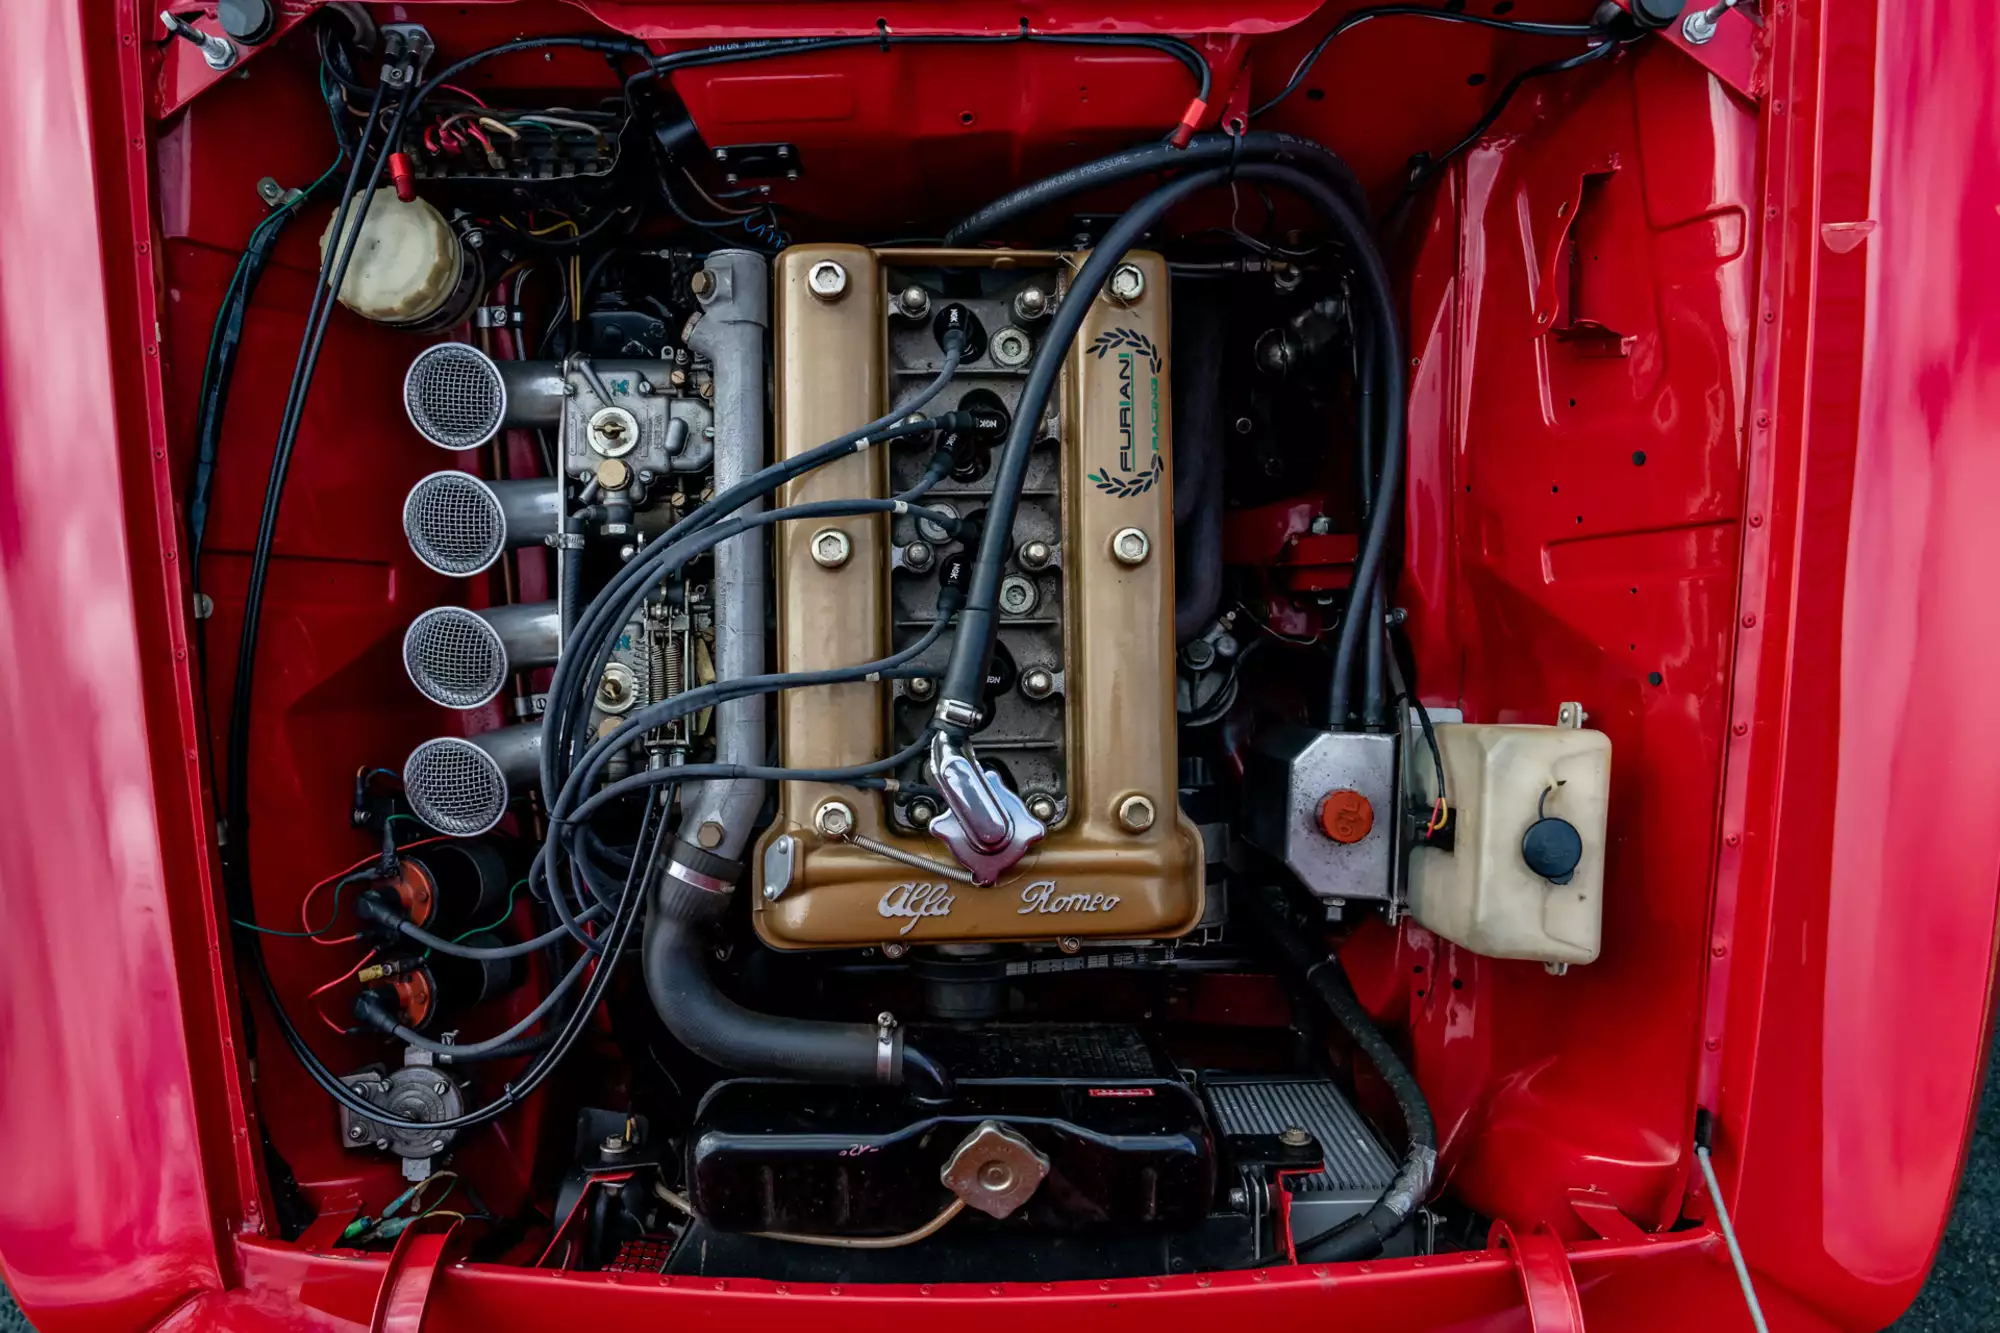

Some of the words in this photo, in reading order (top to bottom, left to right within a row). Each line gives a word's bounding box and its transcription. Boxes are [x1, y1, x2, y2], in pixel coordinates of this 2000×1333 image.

[1034, 171, 1076, 192] WORKING
[1080, 154, 1130, 177] PRESSURE
[950, 308, 958, 323] NGK
[979, 419, 998, 429] NGK
[1118, 353, 1131, 472] FURIANI
[1151, 377, 1159, 451] RACING
[949, 562, 961, 580] NGK
[1337, 801, 1360, 837] OIL
[877, 883, 956, 937] Alfa
[1017, 880, 1121, 915] Romeo
